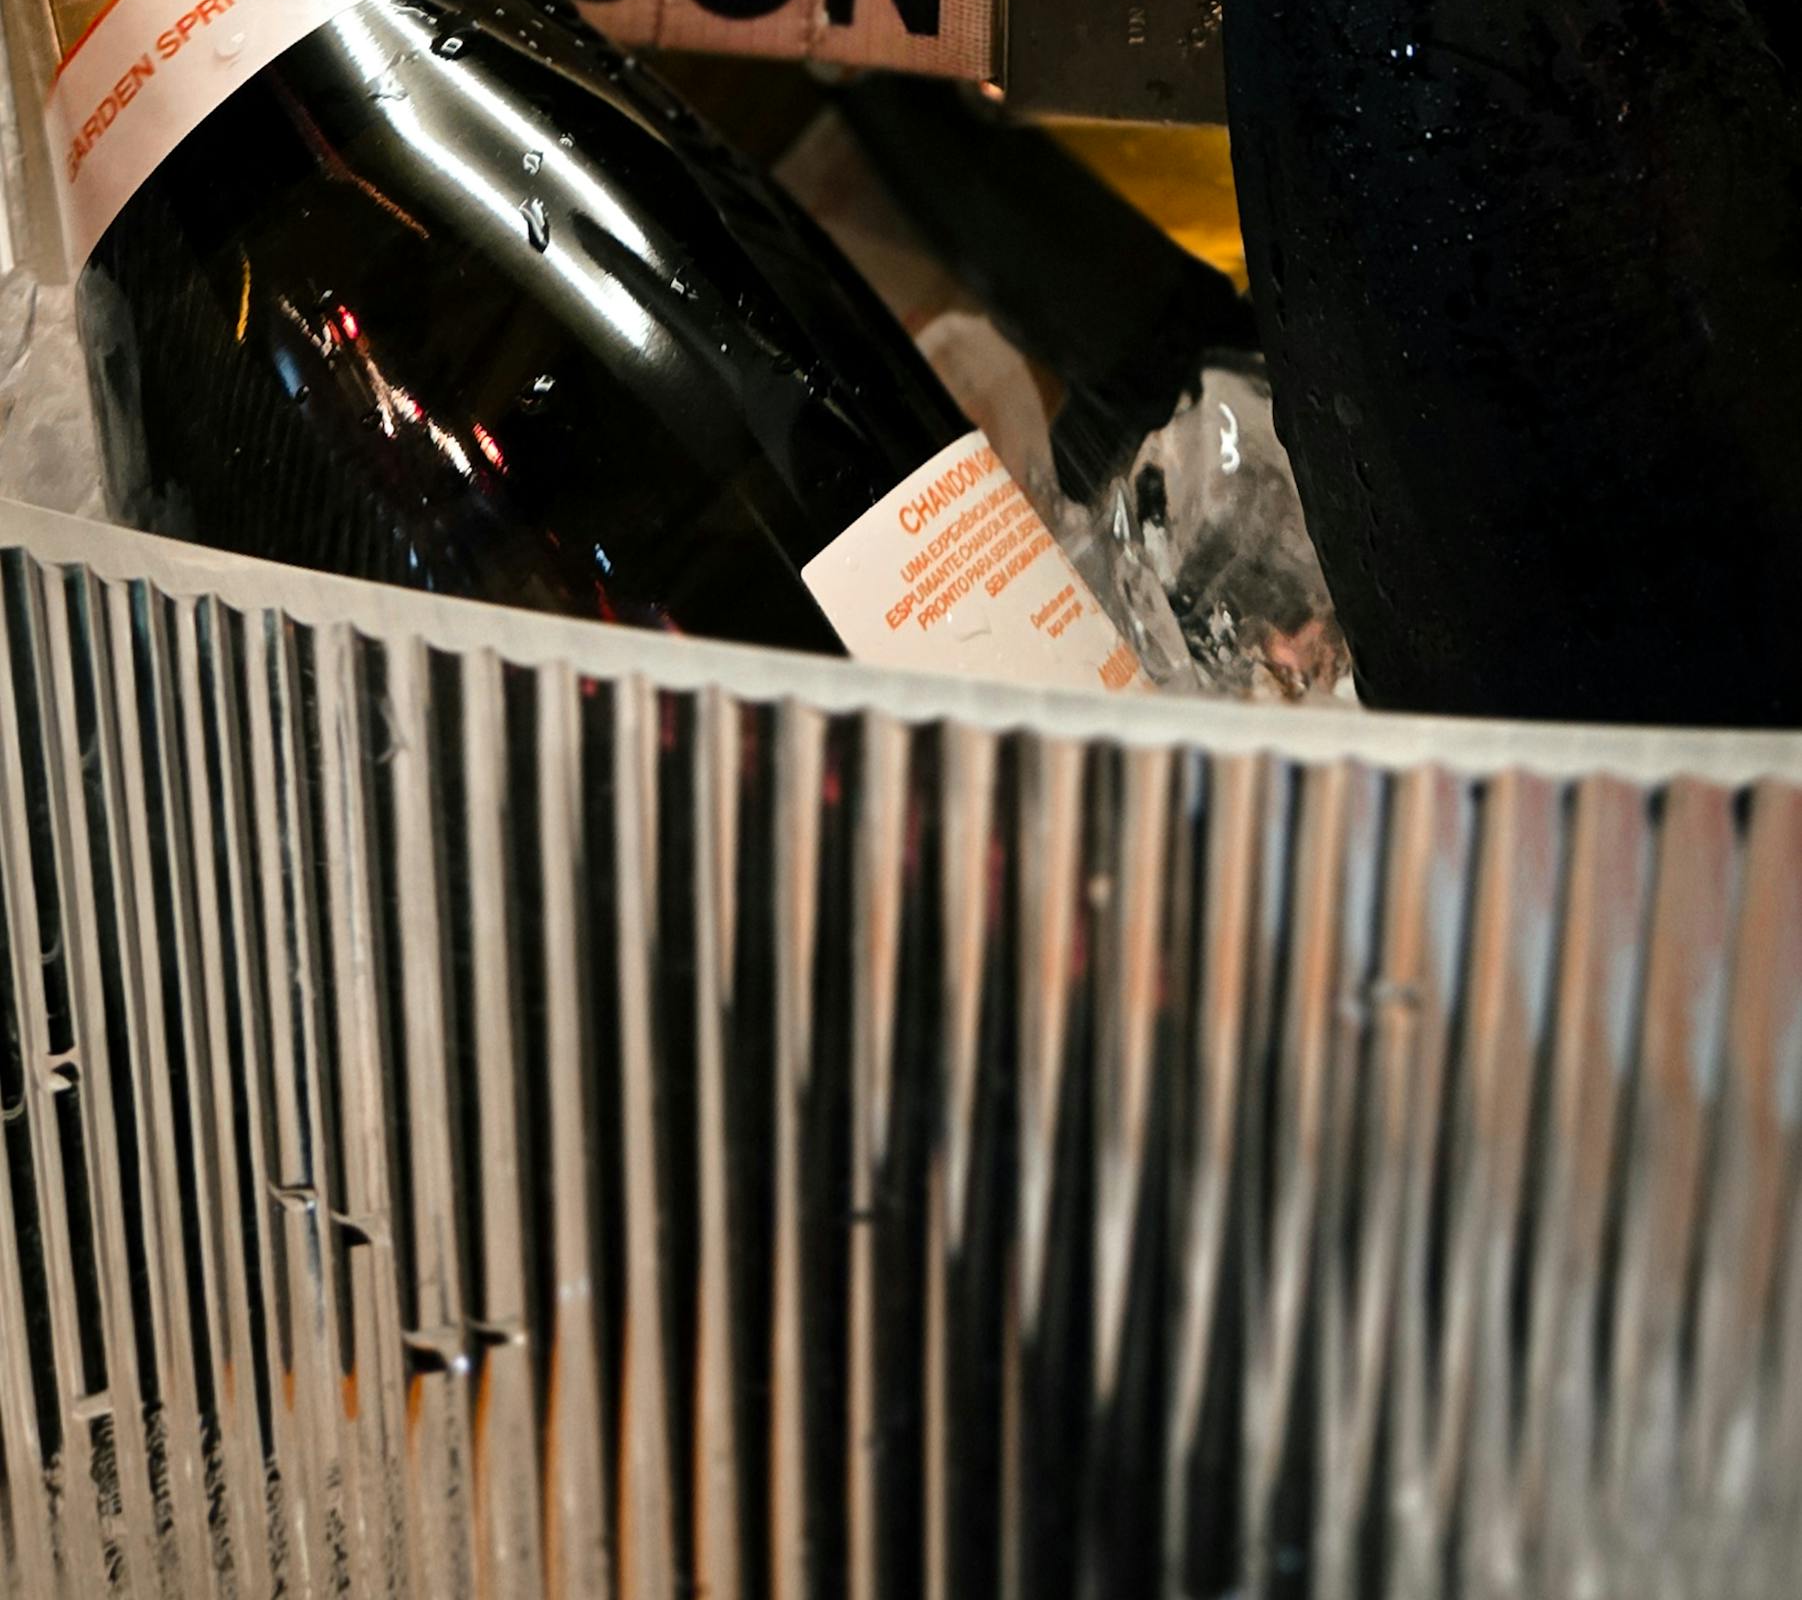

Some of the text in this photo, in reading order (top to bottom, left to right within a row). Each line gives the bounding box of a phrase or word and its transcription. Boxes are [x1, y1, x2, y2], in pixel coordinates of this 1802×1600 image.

[899, 457, 984, 536] CHANDON
[885, 552, 965, 631] ESPUMANTE
[917, 576, 971, 630] PRONTO
